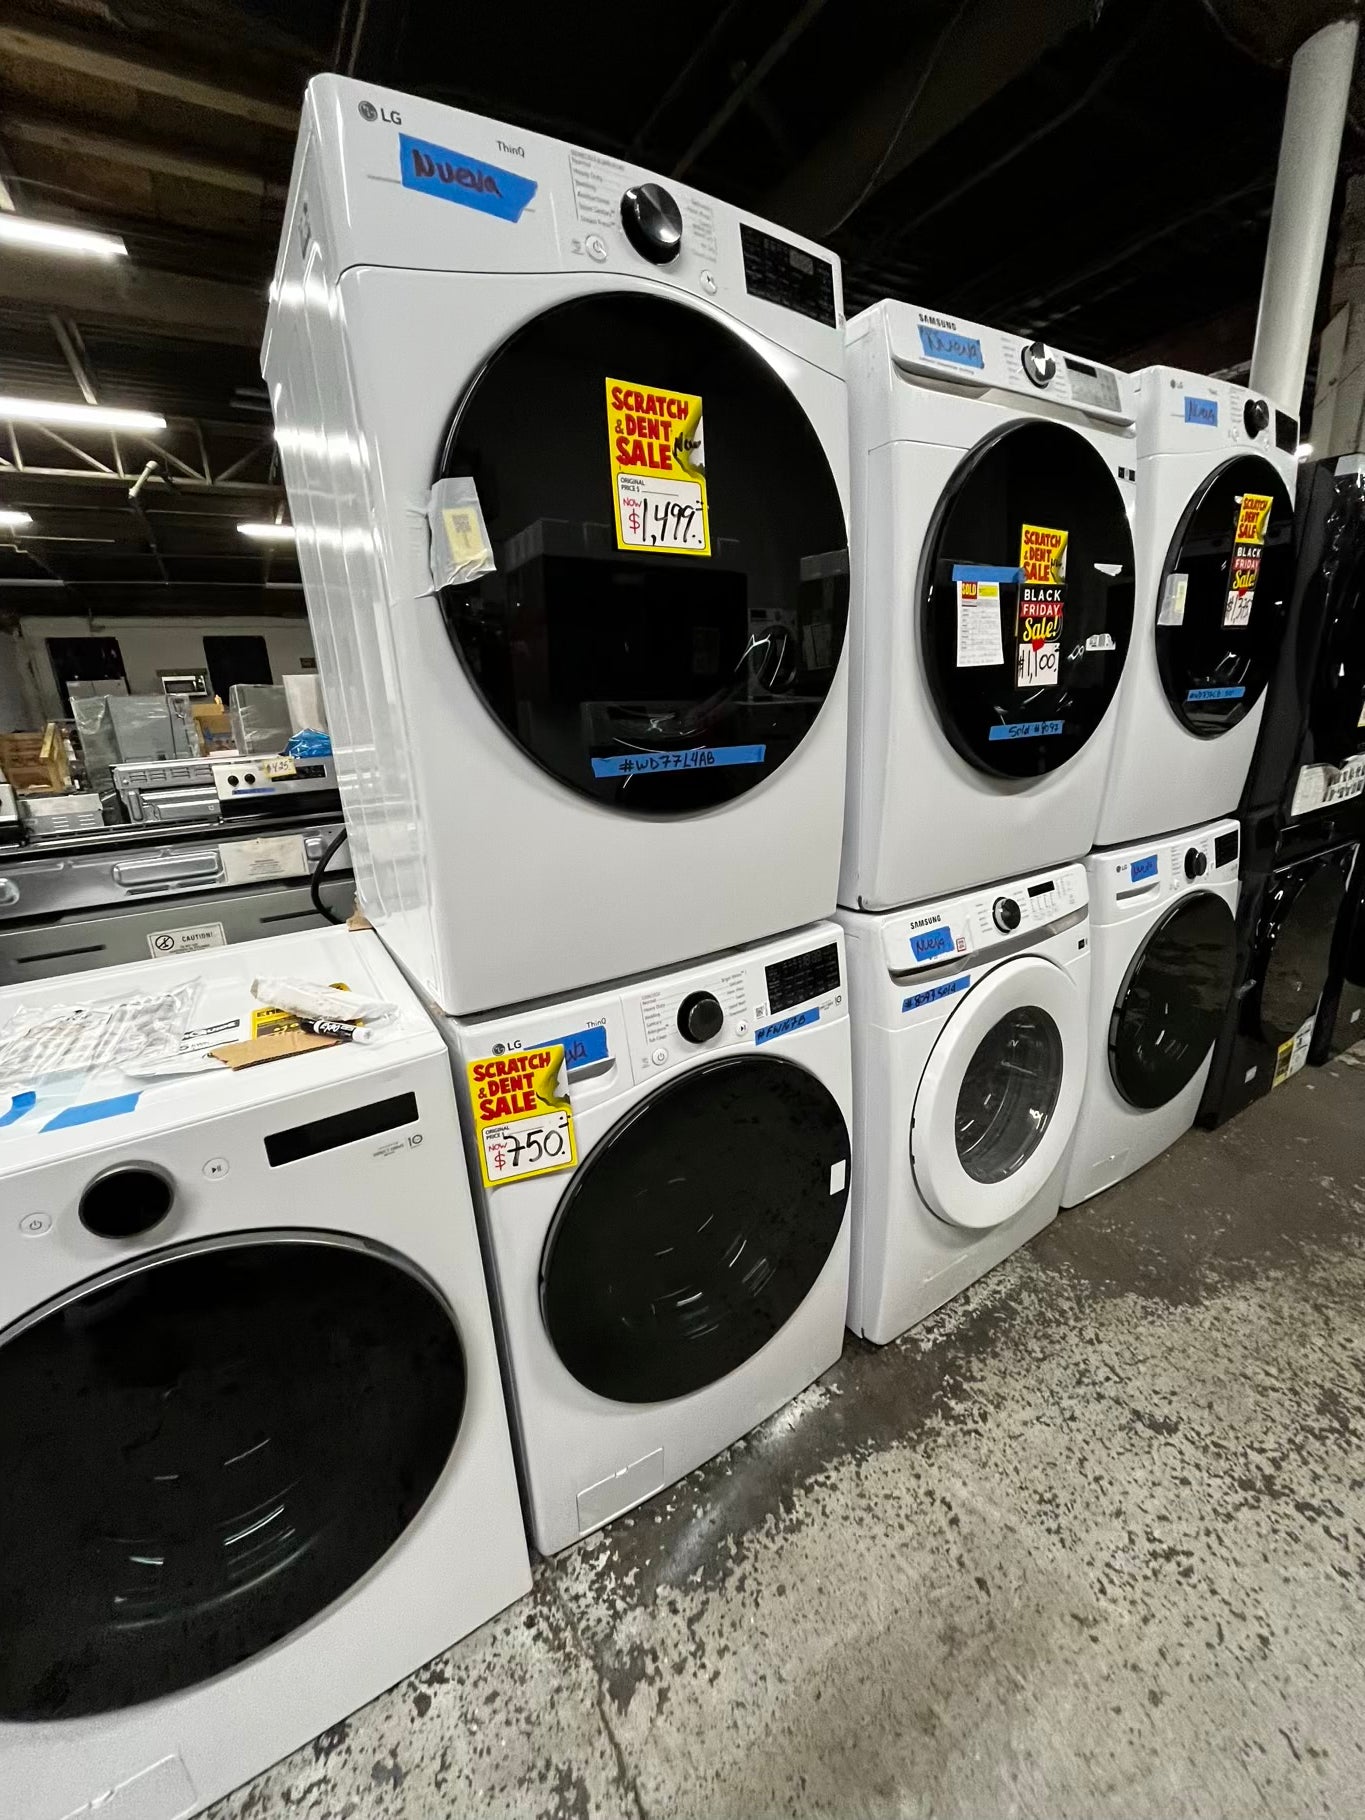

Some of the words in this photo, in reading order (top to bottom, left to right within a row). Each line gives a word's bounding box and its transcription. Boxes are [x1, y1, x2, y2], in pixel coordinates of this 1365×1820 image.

[380, 108, 402, 125] LG
[496, 140, 525, 158] ThinQ
[918, 313, 957, 331] SAMSUNG
[611, 386, 689, 420] SCRATCH
[615, 419, 624, 434] &
[625, 413, 672, 442] DENT
[615, 436, 673, 470] SALE
[620, 477, 645, 486] ORIGINAL
[621, 484, 636, 492] PRICE
[623, 497, 642, 508] NOW
[1237, 523, 1257, 538] SALE
[1024, 529, 1061, 548] SCRATCH
[1029, 546, 1052, 562] DENT
[1237, 547, 1261, 558] BLACK
[1024, 561, 1050, 581] SALE
[1235, 558, 1260, 569] FRIDAY
[1023, 588, 1061, 601] BLACK
[1023, 604, 1060, 616] FRIDAY
[1023, 615, 1059, 641] Sale!
[1009, 725, 1030, 738] Sold
[910, 914, 942, 929] SAMSUNG
[182, 931, 213, 942] CAUTION!
[586, 1018, 607, 1029] ThinQ
[507, 1040, 522, 1051] LG
[473, 1052, 551, 1082] SCRATCH
[478, 1087, 487, 1100] &
[488, 1072, 535, 1097] DENT
[479, 1091, 537, 1121] SALE
[485, 1125, 510, 1135] ORIGINAL
[486, 1132, 501, 1140] PRICE
[488, 1142, 508, 1152] NOW
